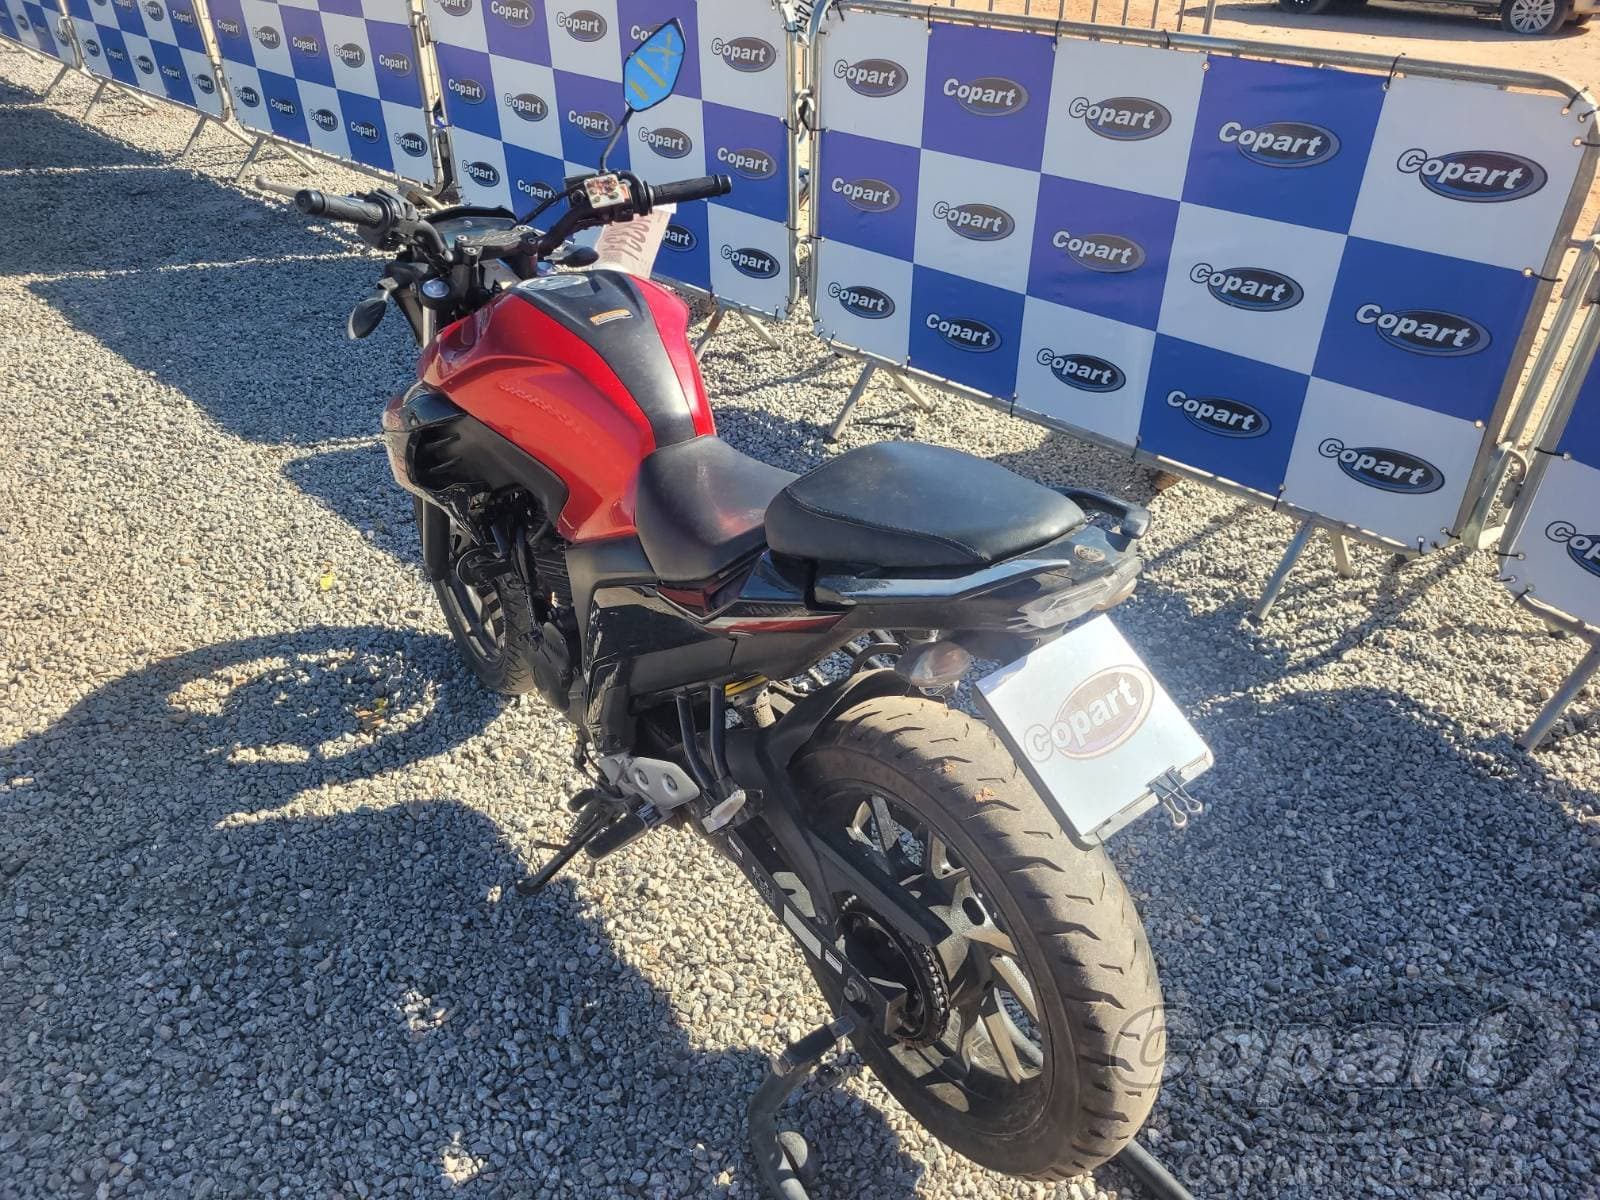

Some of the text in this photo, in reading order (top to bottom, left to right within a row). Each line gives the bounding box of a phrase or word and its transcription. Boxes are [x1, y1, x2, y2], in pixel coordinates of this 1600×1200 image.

[491, 1, 530, 21] Copart
[217, 19, 239, 34] Copart
[557, 12, 599, 34] Copart
[253, 27, 277, 43] Copart
[292, 36, 318, 53] Copart
[334, 44, 362, 61] Copart
[711, 38, 765, 62] Copart
[378, 54, 409, 71] Copart
[833, 59, 897, 88] Copart
[234, 86, 257, 102] Copart
[448, 78, 480, 97] Copart
[943, 78, 1017, 106] Copart
[270, 98, 294, 114] Copart
[504, 93, 541, 113] Copart
[1069, 97, 1157, 129] Copart
[310, 110, 335, 127] Copart
[350, 121, 377, 138] Copart
[568, 110, 608, 131] Copart
[394, 133, 423, 151] Copart
[638, 127, 684, 150] Copart
[1218, 120, 1323, 158] Copart
[461, 160, 494, 180] Copart
[717, 148, 768, 171] Copart
[1396, 148, 1524, 191] Copart
[517, 179, 555, 199] Copart
[831, 177, 890, 204] Copart
[933, 201, 1003, 233] Copart
[664, 228, 690, 246] part
[1052, 230, 1133, 265] Copart
[721, 245, 771, 271] Copart
[1189, 262, 1287, 303] Copart
[827, 282, 885, 312] Copart
[925, 312, 991, 346] Copart
[1354, 303, 1474, 348] Copart
[1036, 347, 1113, 386] Copart
[1166, 390, 1256, 432] Copart
[1318, 437, 1425, 487] Copart
[1024, 677, 1137, 762] Copart
